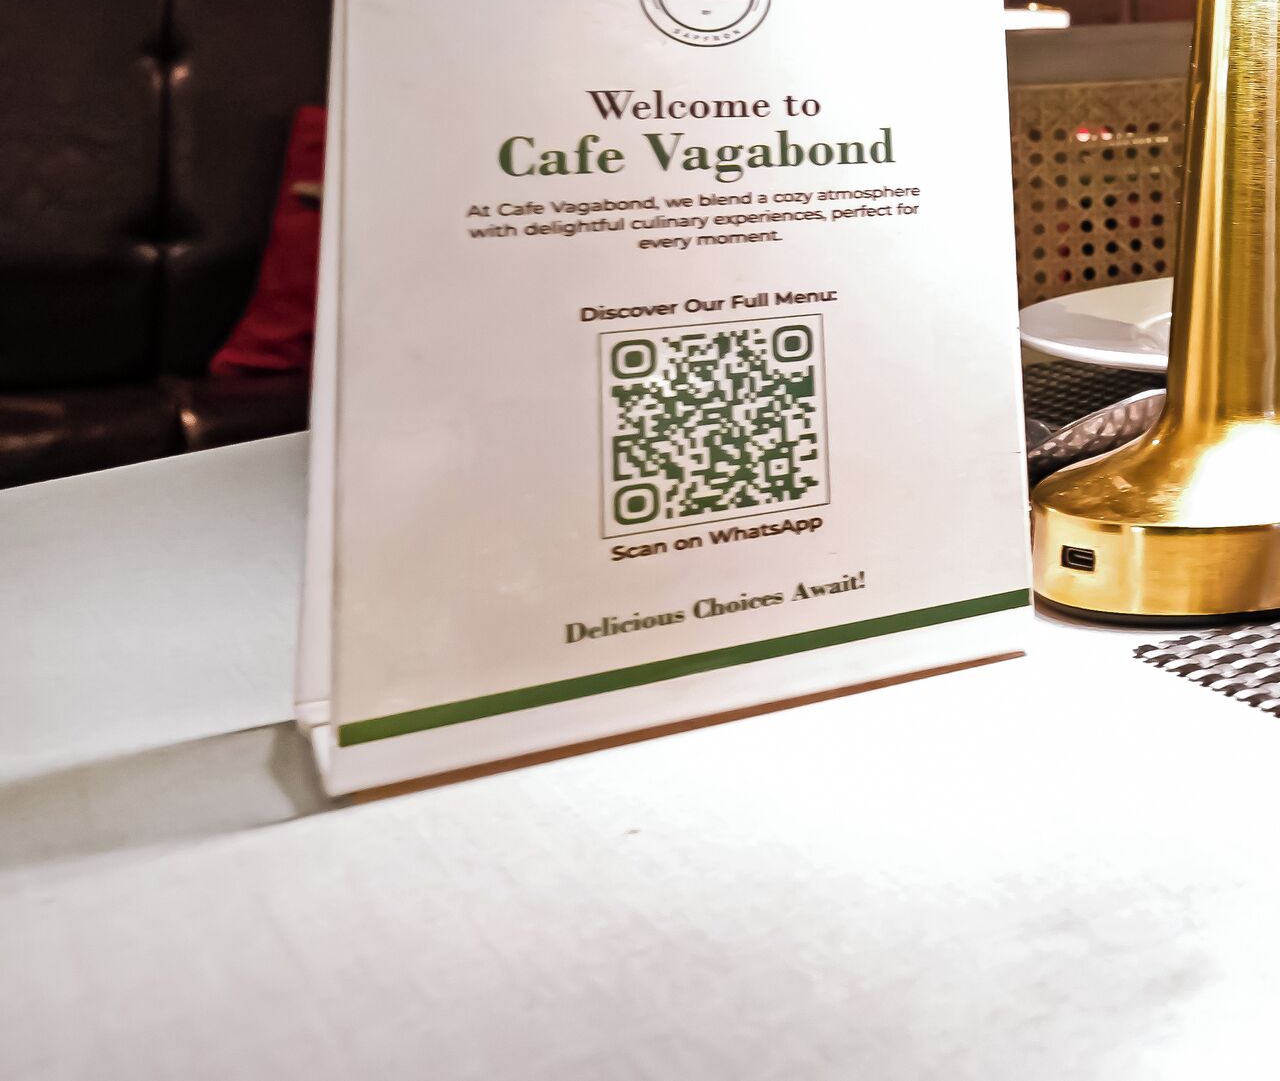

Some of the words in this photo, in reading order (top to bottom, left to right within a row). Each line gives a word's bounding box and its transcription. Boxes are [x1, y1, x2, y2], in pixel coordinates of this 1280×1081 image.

[586, 90, 772, 120] Welcome
[783, 95, 821, 118] to
[498, 134, 626, 177] Cafe
[642, 127, 897, 184] Vagabond
[466, 204, 490, 218] At
[497, 201, 545, 217] Cafe
[550, 196, 660, 216] Vagabond,
[664, 197, 693, 208] we
[699, 192, 752, 207] blend
[757, 193, 768, 204] a
[773, 190, 813, 205] cozy
[817, 186, 921, 201] atmosphere
[468, 223, 518, 239] with
[524, 218, 625, 237] delightful
[631, 215, 709, 229] culinary
[714, 210, 827, 227] experiences,
[831, 204, 893, 222] perfect
[897, 203, 920, 216] for
[638, 235, 692, 250] every
[697, 230, 783, 246] moment.
[579, 302, 678, 322] Discover
[684, 298, 726, 313] Our
[731, 293, 769, 308] Full
[775, 290, 838, 305] Menu:
[611, 540, 668, 561] Scan
[674, 535, 703, 550] on
[709, 516, 823, 545] WhatsApp
[565, 611, 686, 644] Delicious
[693, 592, 784, 620] Choices
[791, 571, 866, 601] Await!
